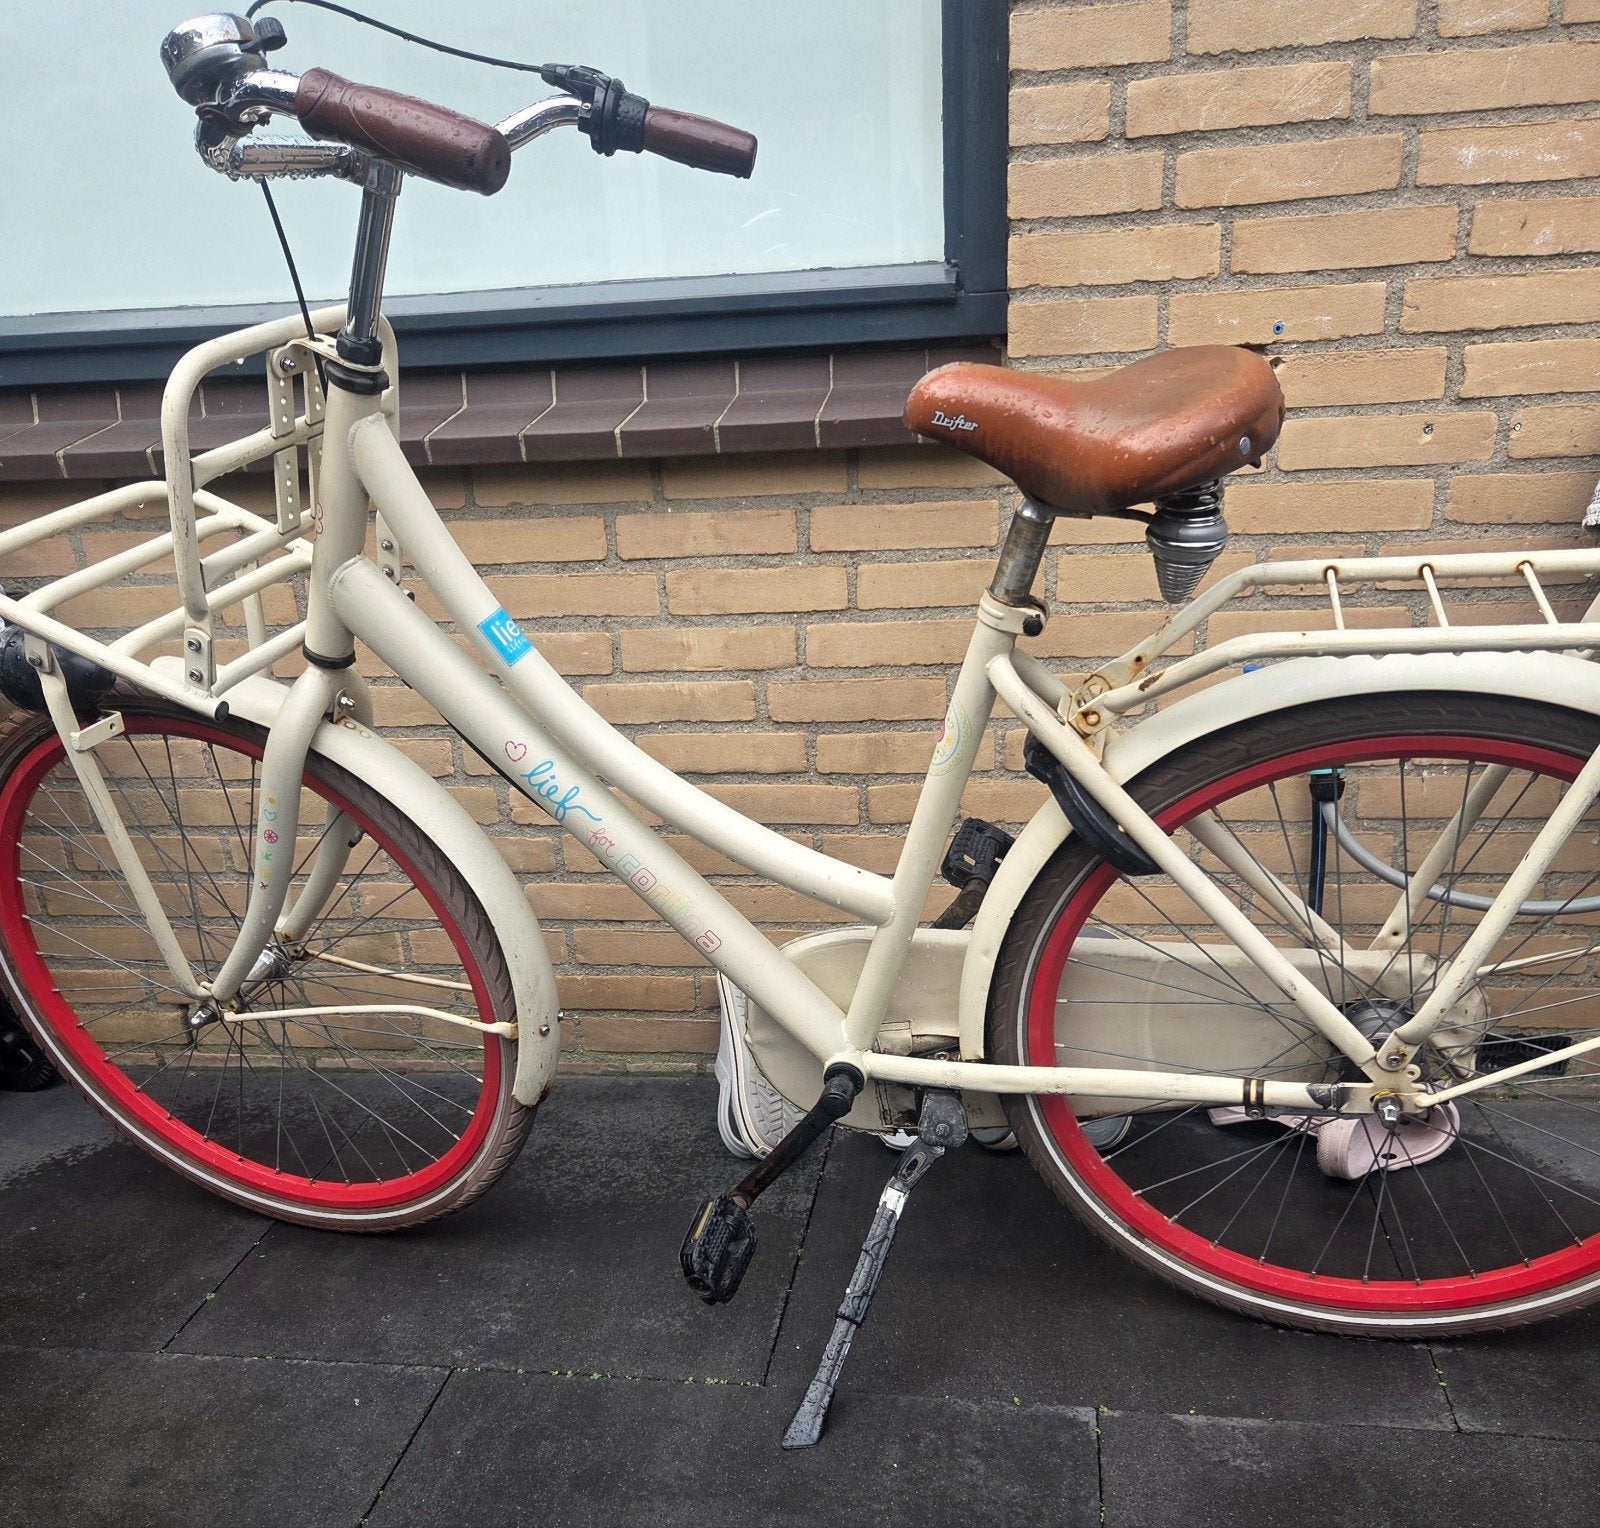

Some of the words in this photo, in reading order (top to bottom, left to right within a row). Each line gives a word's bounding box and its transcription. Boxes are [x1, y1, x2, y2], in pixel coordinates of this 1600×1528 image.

[931, 410, 978, 431] Drifter
[521, 760, 602, 821] lief
[589, 828, 616, 858] for
[616, 853, 721, 954] cortina
